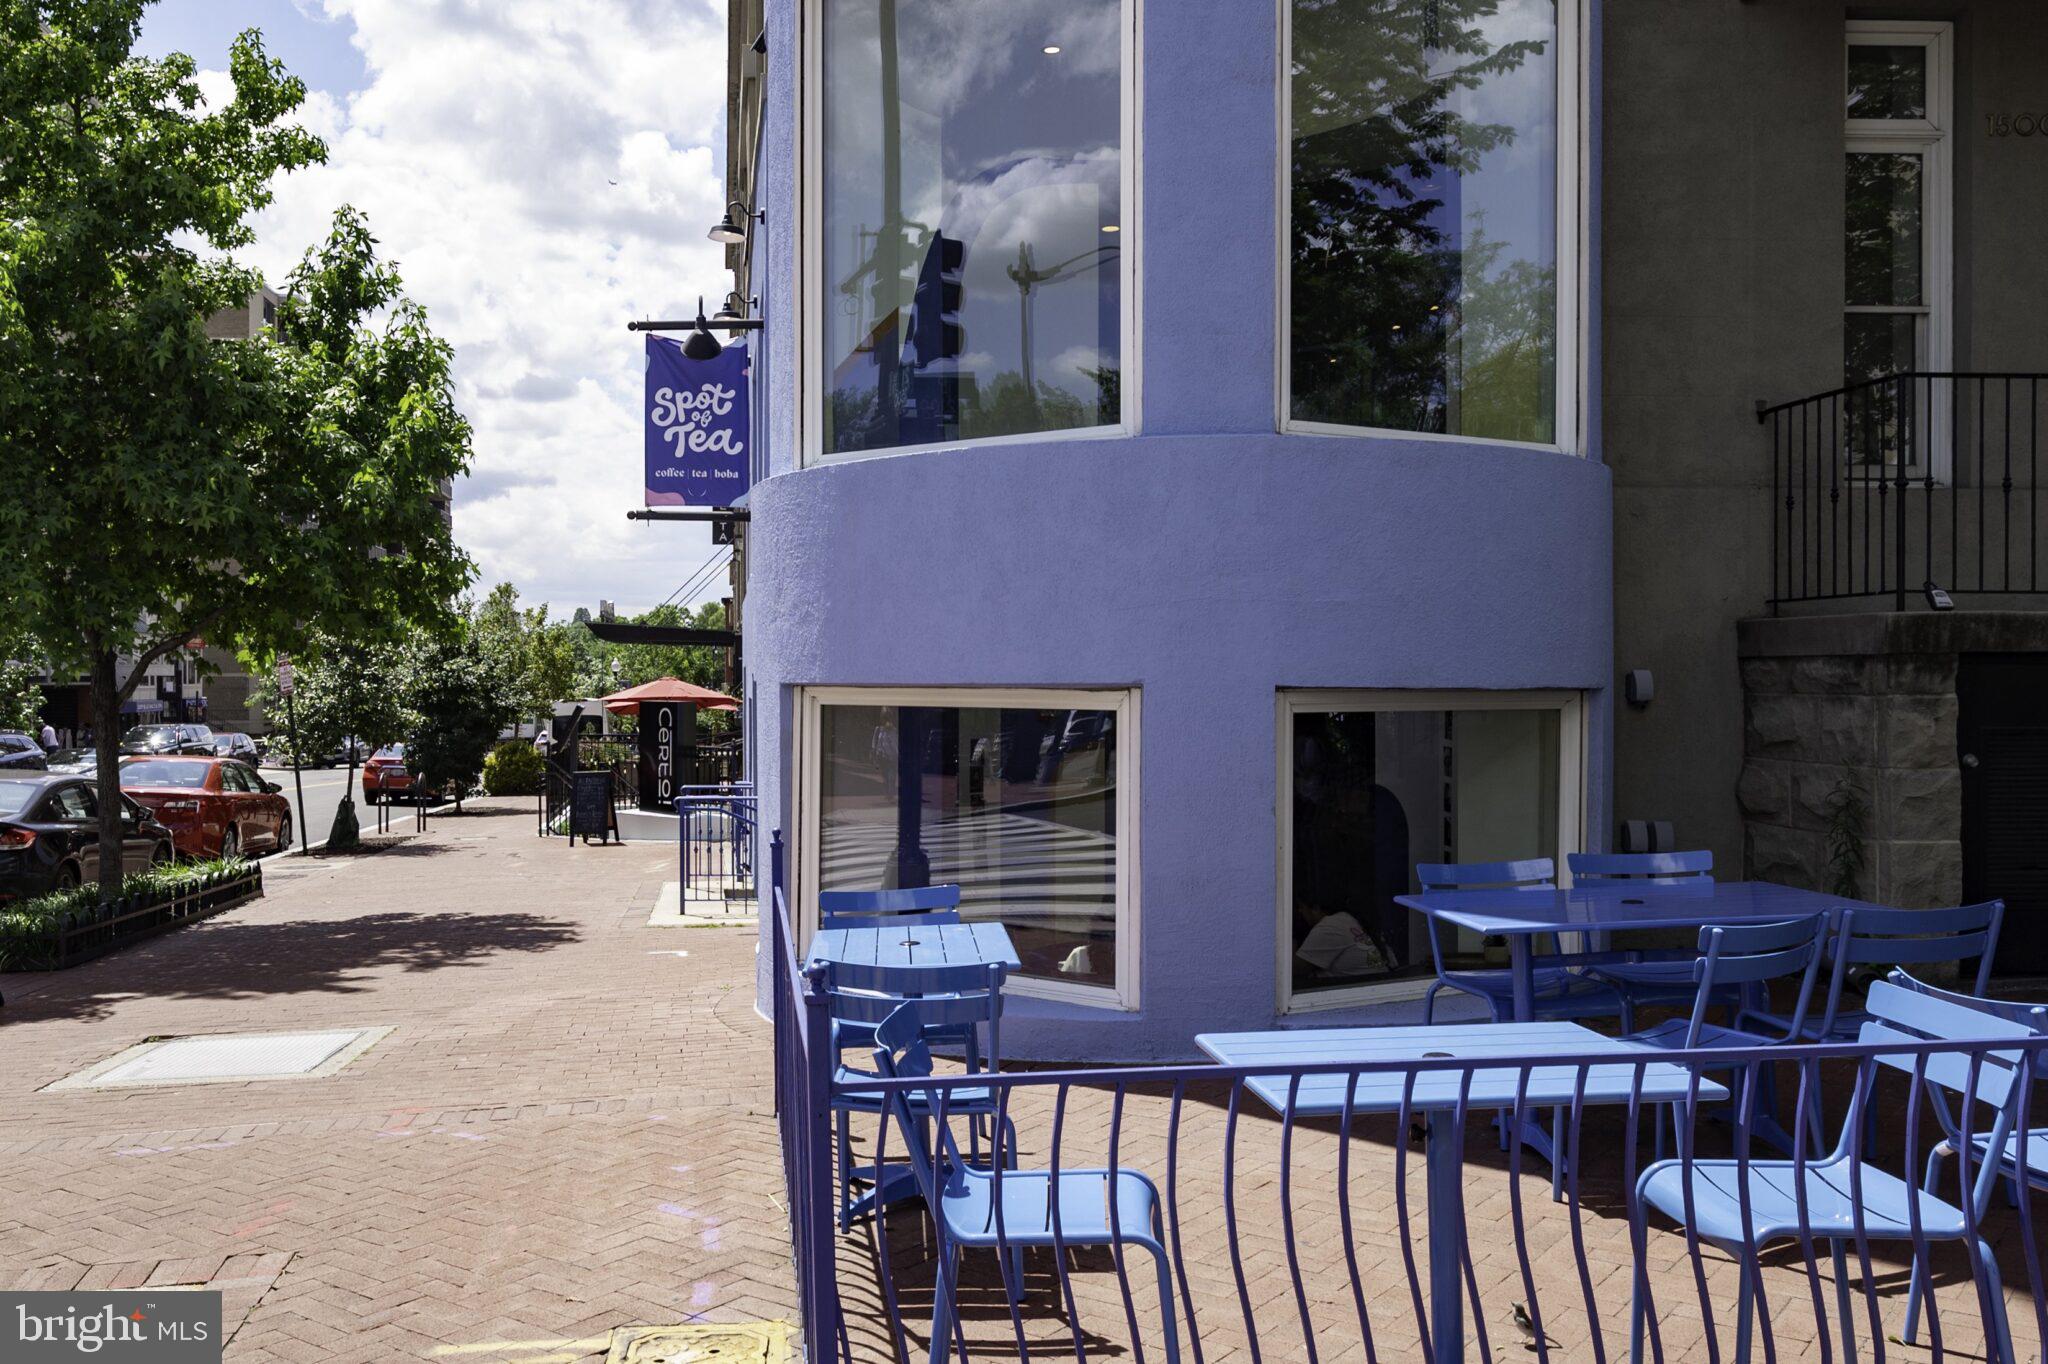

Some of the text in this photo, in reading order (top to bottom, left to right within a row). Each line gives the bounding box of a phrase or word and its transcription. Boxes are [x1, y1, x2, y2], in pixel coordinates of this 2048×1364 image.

[651, 383, 736, 426] Spot
[691, 410, 712, 427] of
[664, 422, 744, 458] Tea
[655, 467, 739, 478] coffee tea boba
